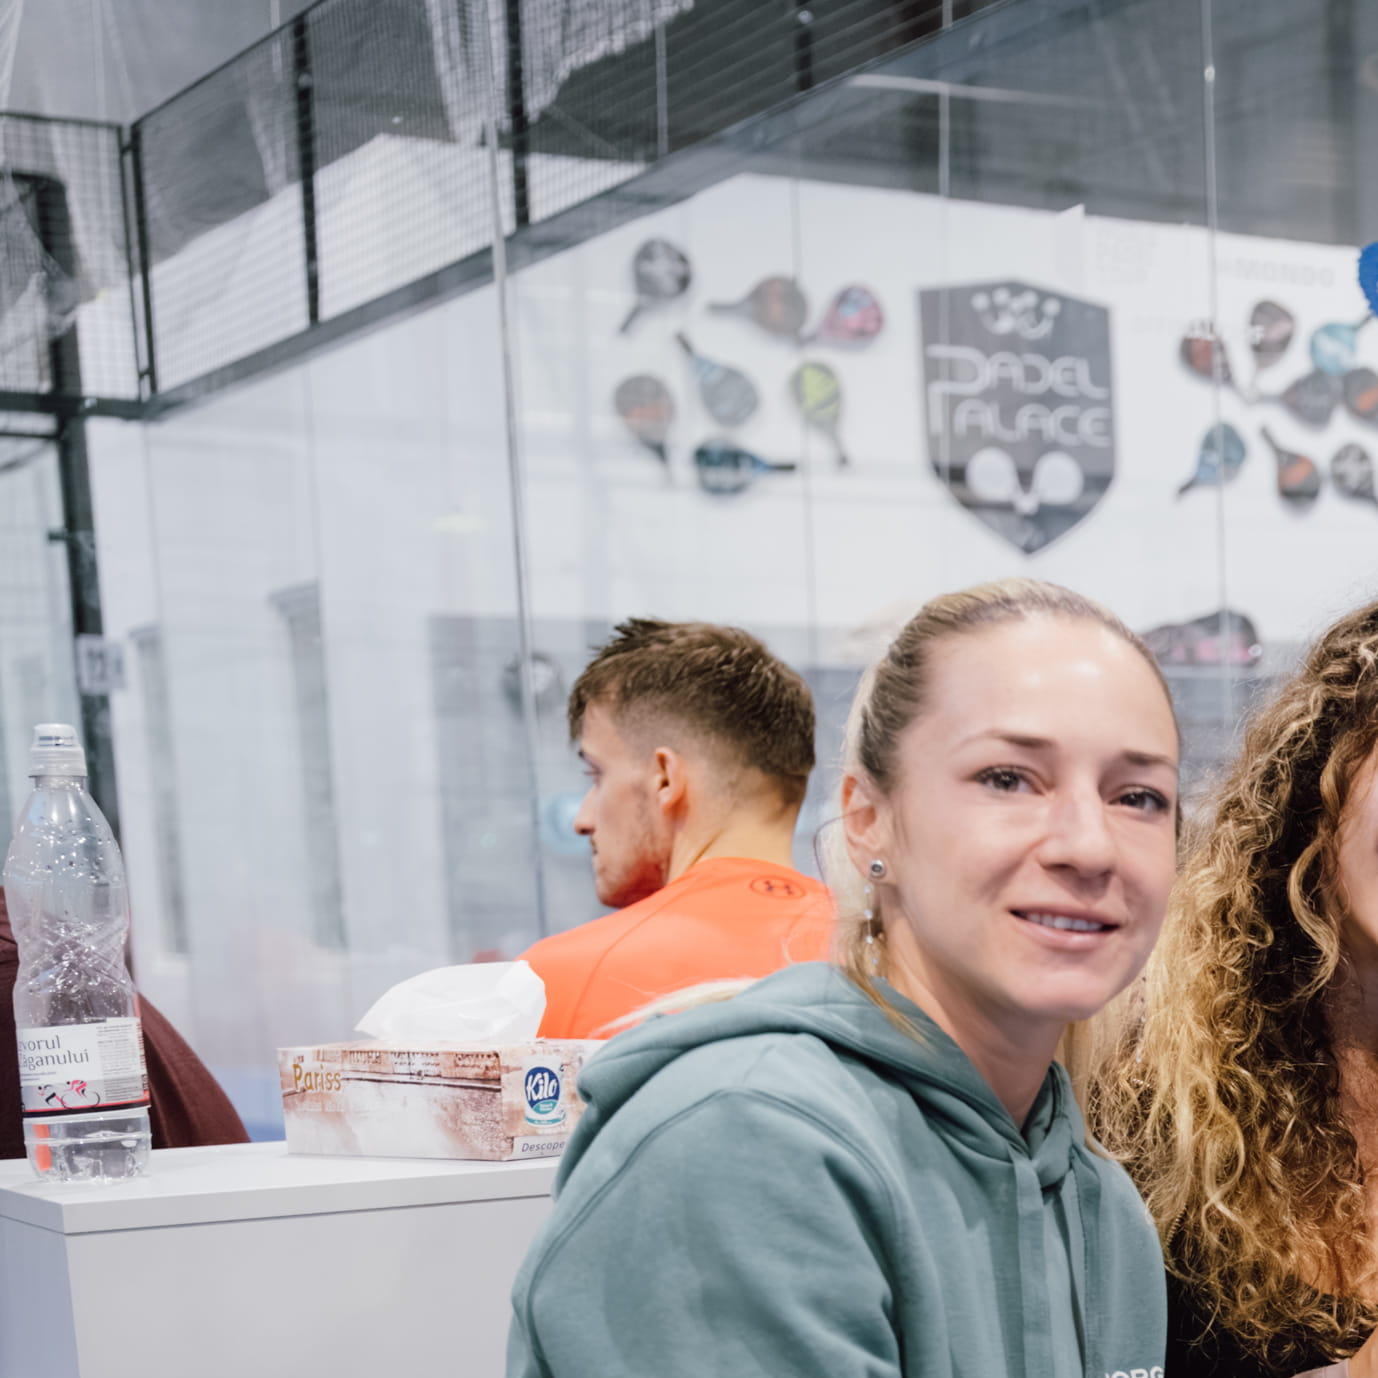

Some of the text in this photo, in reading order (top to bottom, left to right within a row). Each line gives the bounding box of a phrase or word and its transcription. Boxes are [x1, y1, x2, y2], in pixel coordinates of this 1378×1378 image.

[926, 344, 1110, 400] PADEL
[927, 385, 1112, 448] PALACE
[293, 1063, 342, 1091] Pariss
[527, 1072, 558, 1101] Kilo
